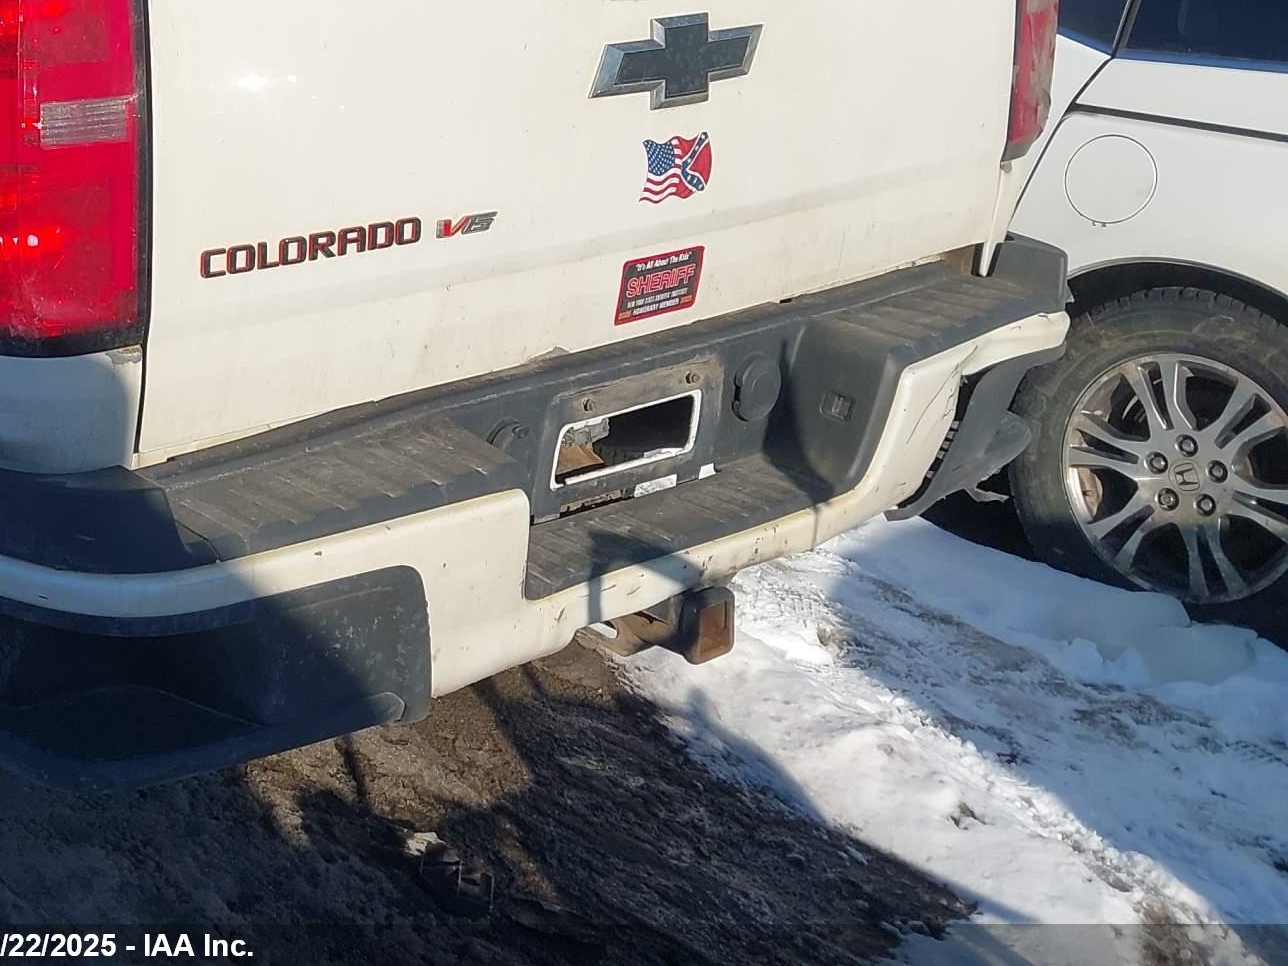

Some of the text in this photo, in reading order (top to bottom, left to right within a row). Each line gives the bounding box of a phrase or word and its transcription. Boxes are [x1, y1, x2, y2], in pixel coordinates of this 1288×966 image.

[199, 210, 499, 280] COLORADO V6
[626, 264, 697, 299] SHERIFF
[659, 298, 680, 309] MEMBER
